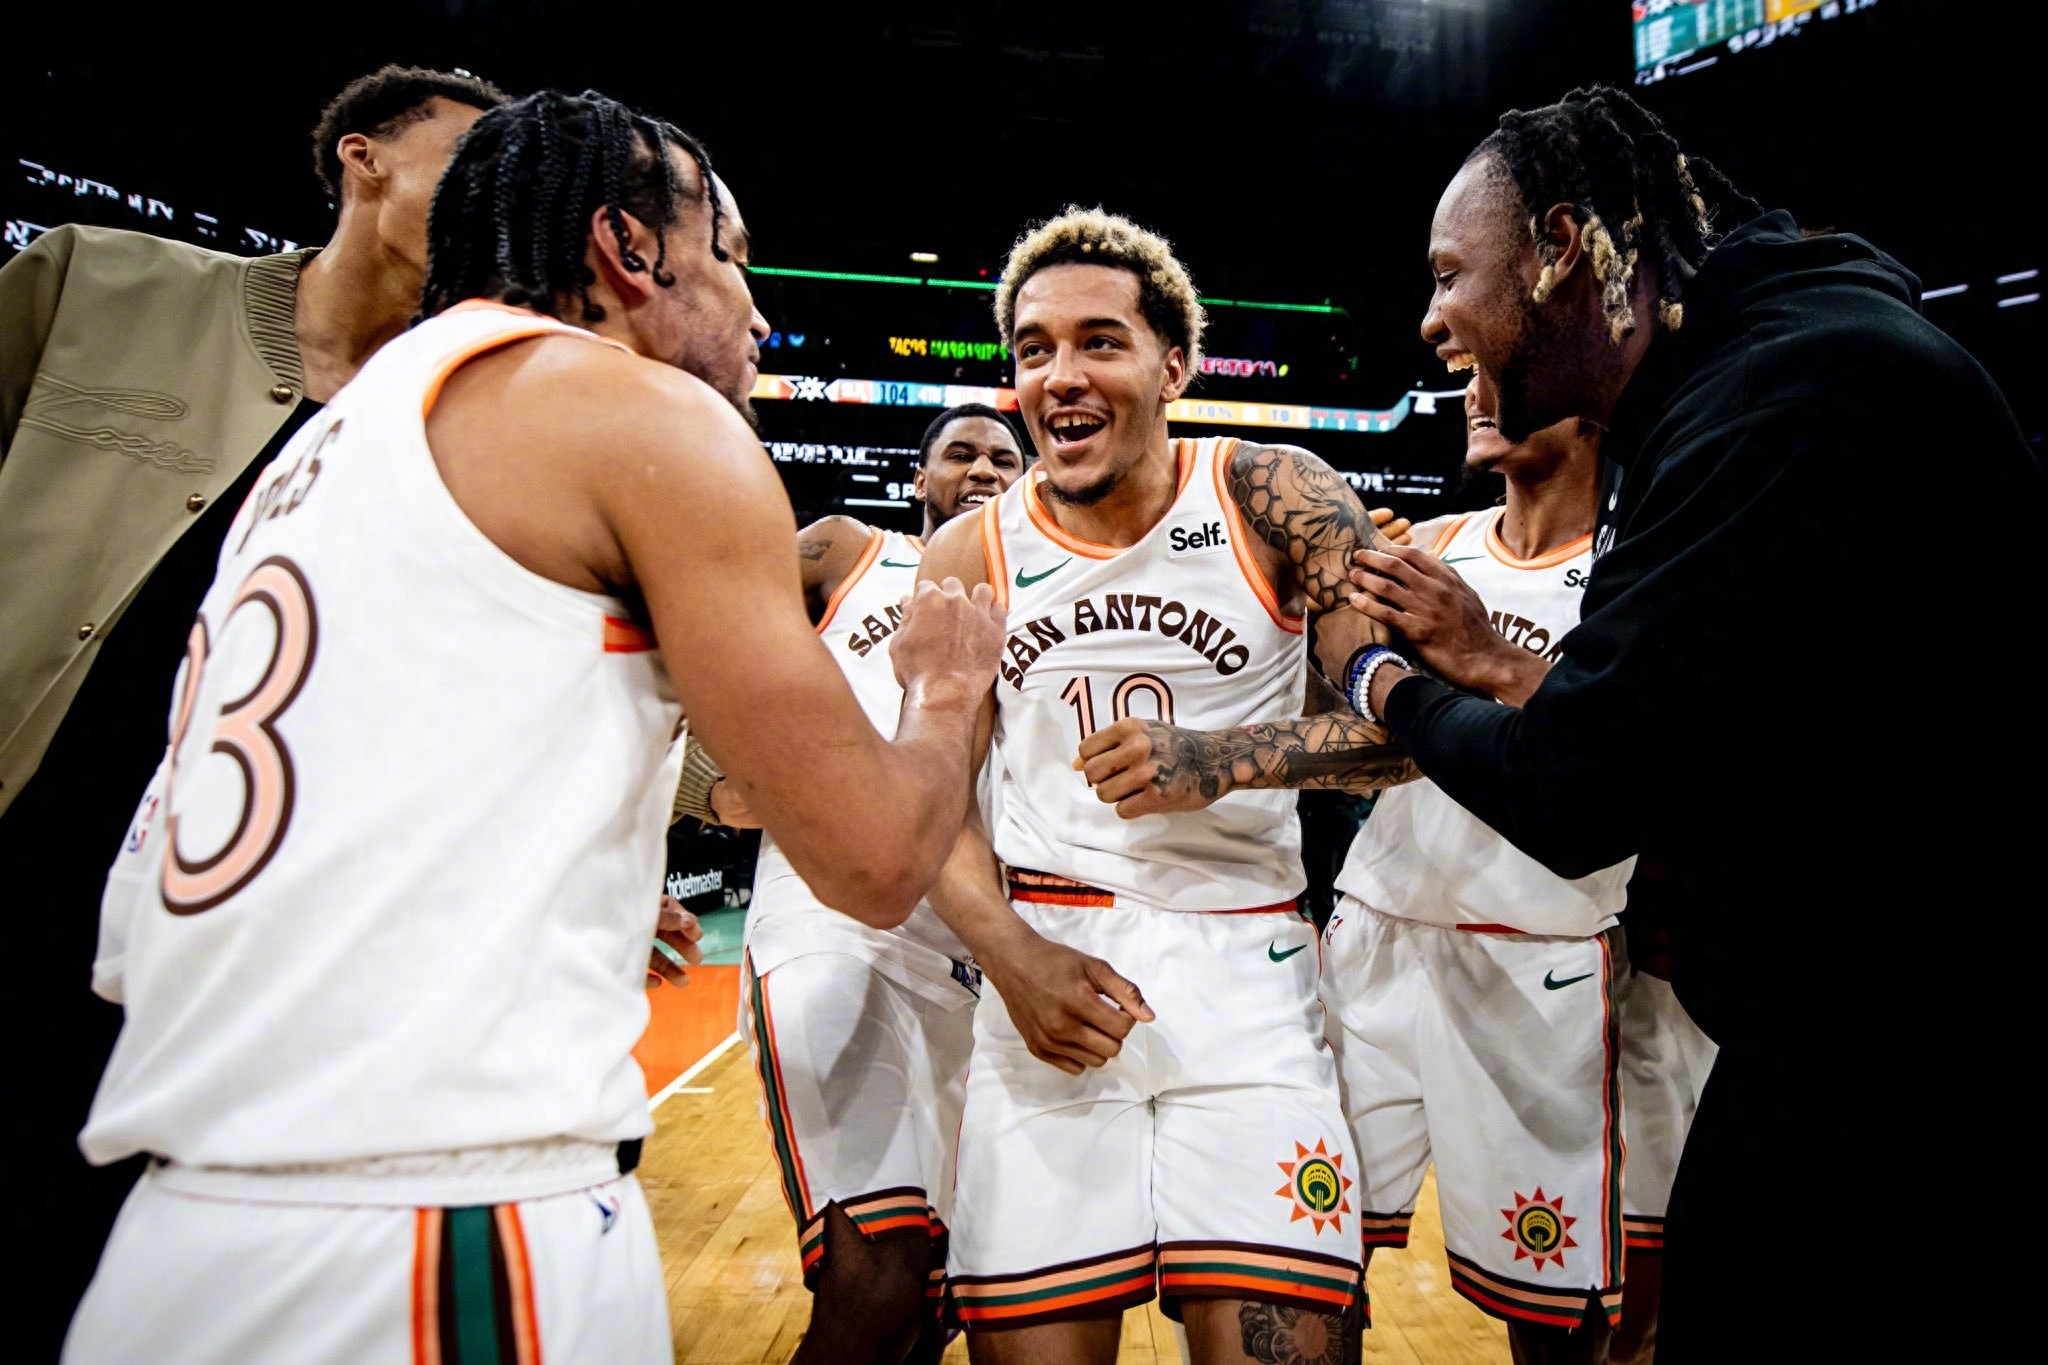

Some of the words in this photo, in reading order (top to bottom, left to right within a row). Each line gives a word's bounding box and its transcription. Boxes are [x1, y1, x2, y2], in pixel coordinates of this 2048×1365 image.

[880, 384, 908, 405] 104
[1170, 521, 1227, 552] Self.
[1000, 616, 1065, 692] SAN
[1074, 593, 1250, 676] ANTONIO
[666, 868, 723, 901] ticketmaster
